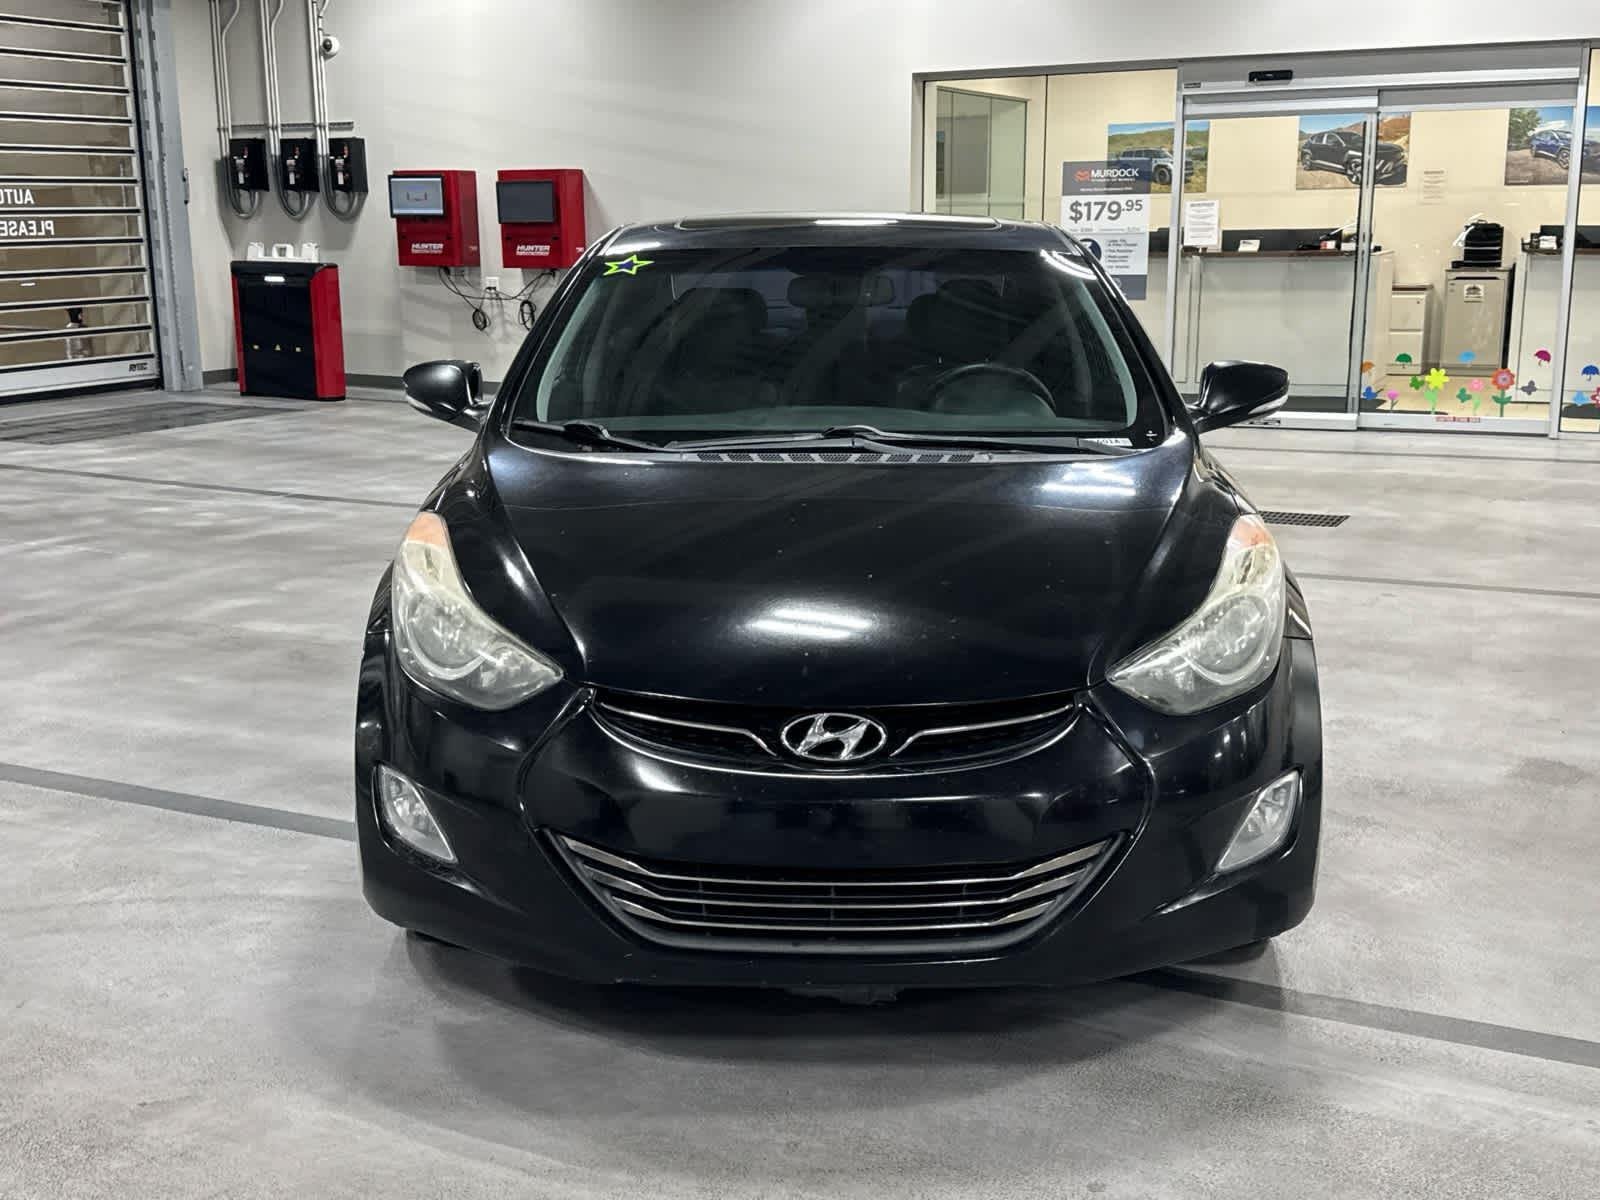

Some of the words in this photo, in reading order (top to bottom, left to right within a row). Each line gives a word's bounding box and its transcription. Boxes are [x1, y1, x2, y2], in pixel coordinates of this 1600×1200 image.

[1090, 168, 1140, 178] MURDOCK
[1069, 199, 1144, 224] $179.95
[516, 244, 551, 252] HUNTER
